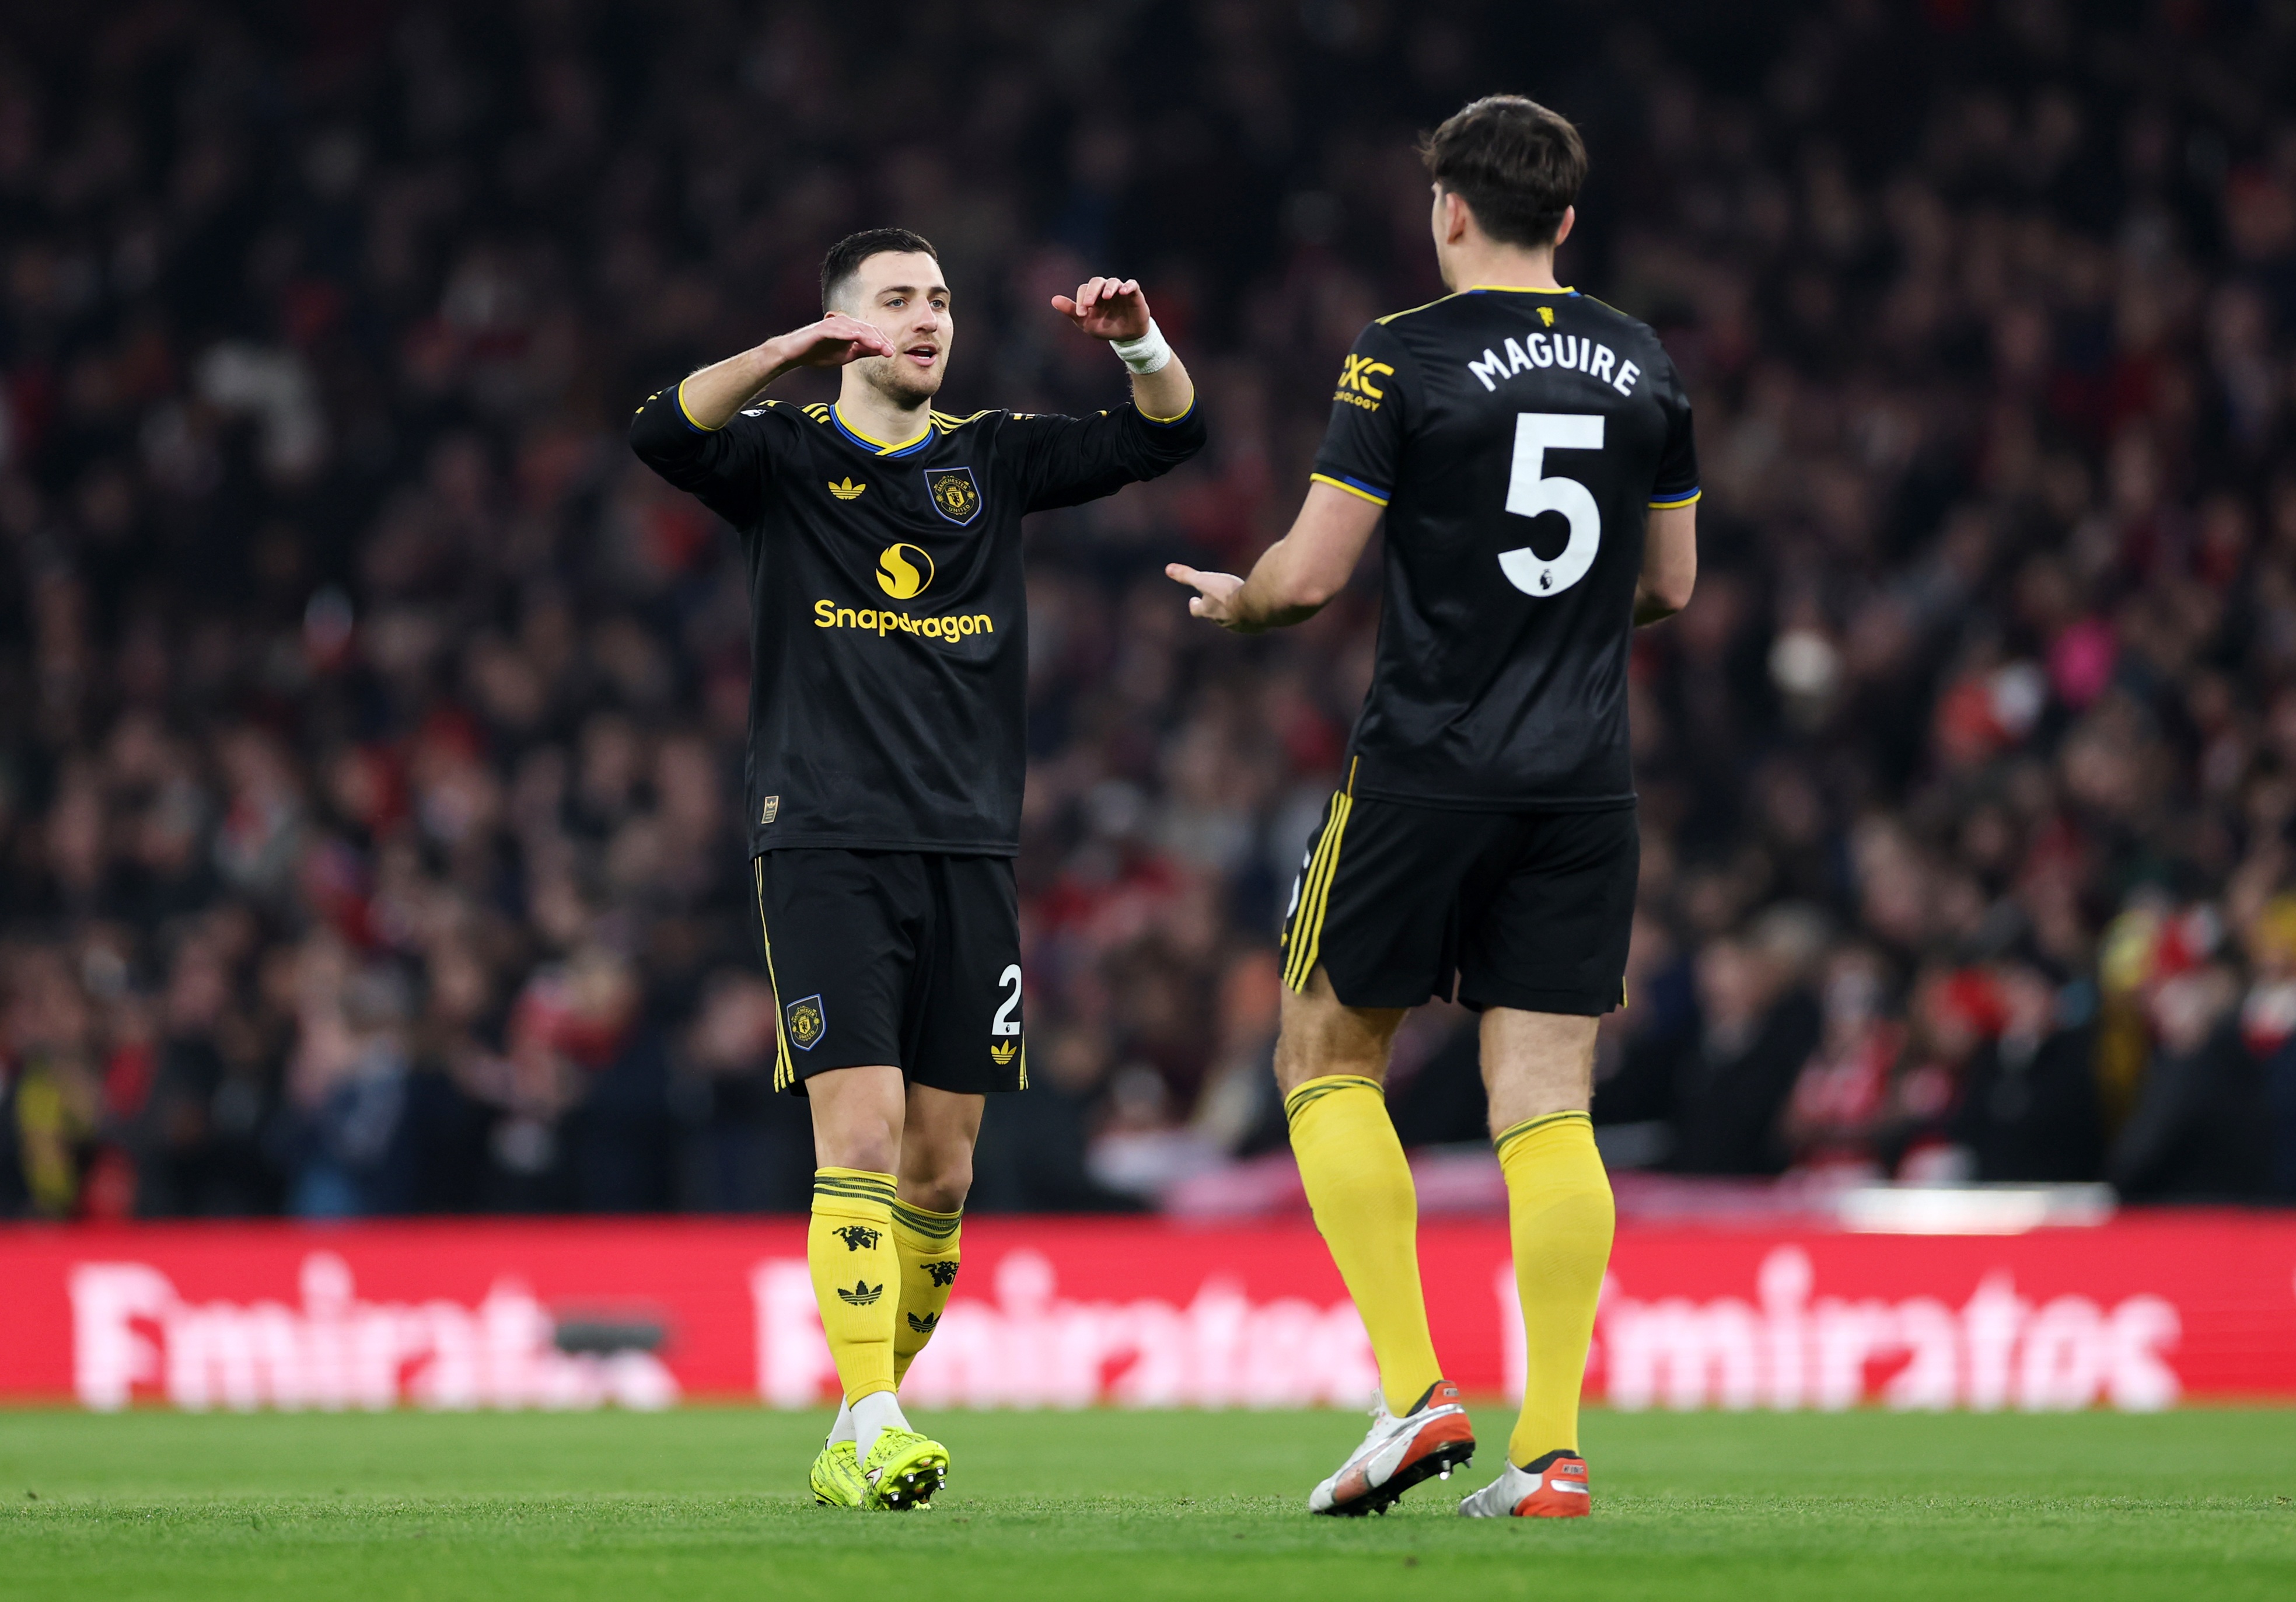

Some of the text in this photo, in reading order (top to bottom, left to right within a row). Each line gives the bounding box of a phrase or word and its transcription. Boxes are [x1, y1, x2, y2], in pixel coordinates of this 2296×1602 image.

[1467, 332, 1641, 397] MAGUIRE
[937, 479, 968, 493] MANCHESTER
[949, 504, 970, 512] UNITED
[1497, 412, 1605, 598] 5
[814, 599, 994, 643] Snapdragon
[991, 964, 1022, 1036] 2
[799, 1031, 815, 1039] UNITED
